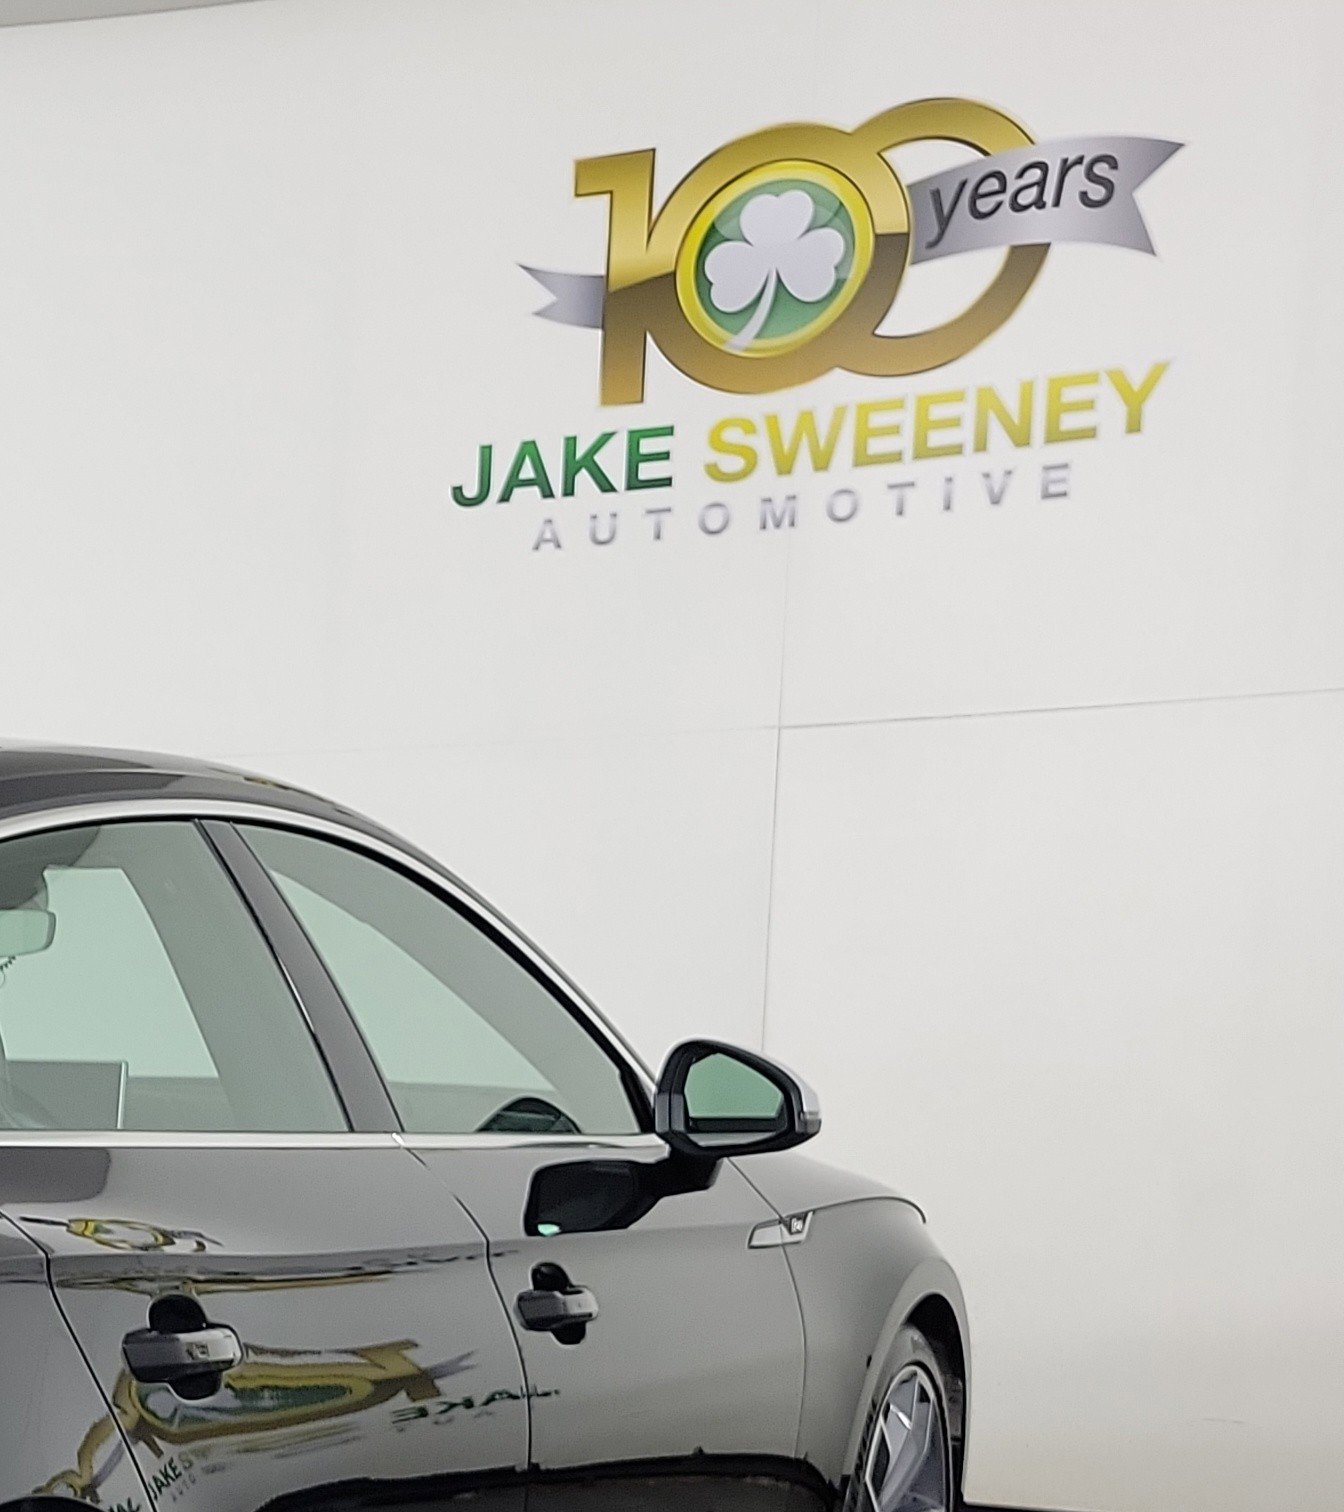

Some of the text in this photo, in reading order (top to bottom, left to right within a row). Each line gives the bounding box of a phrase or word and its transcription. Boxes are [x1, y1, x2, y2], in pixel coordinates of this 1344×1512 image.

[573, 96, 1053, 407] 100
[925, 152, 1119, 248] years
[450, 362, 1172, 507] JAKE SWEENEY
[532, 463, 1073, 553] AUTOMOTIVE
